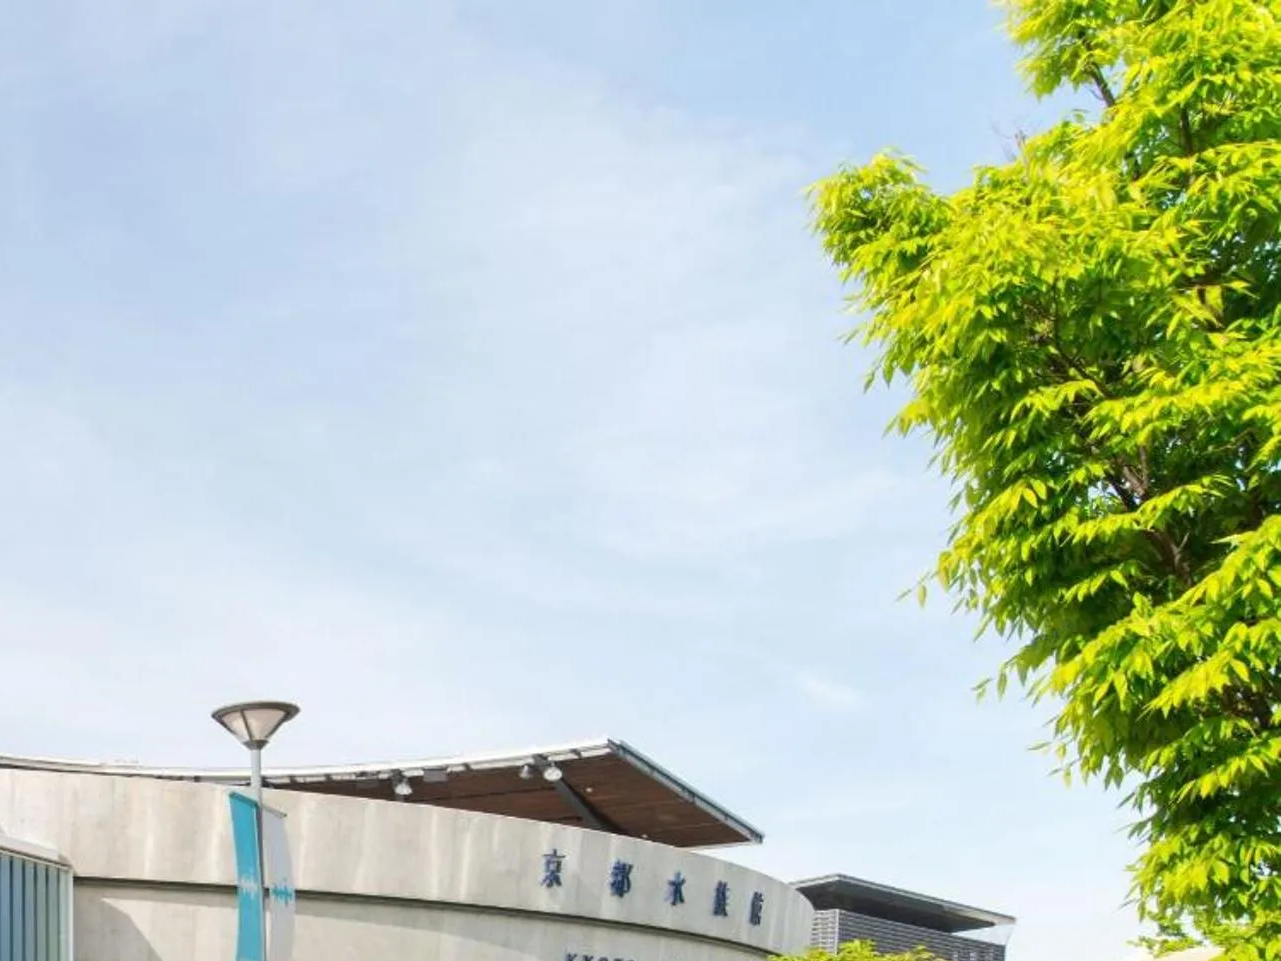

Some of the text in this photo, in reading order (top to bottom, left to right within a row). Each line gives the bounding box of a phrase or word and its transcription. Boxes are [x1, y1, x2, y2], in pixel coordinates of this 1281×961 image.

[540, 848, 765, 926] 京都水族館
